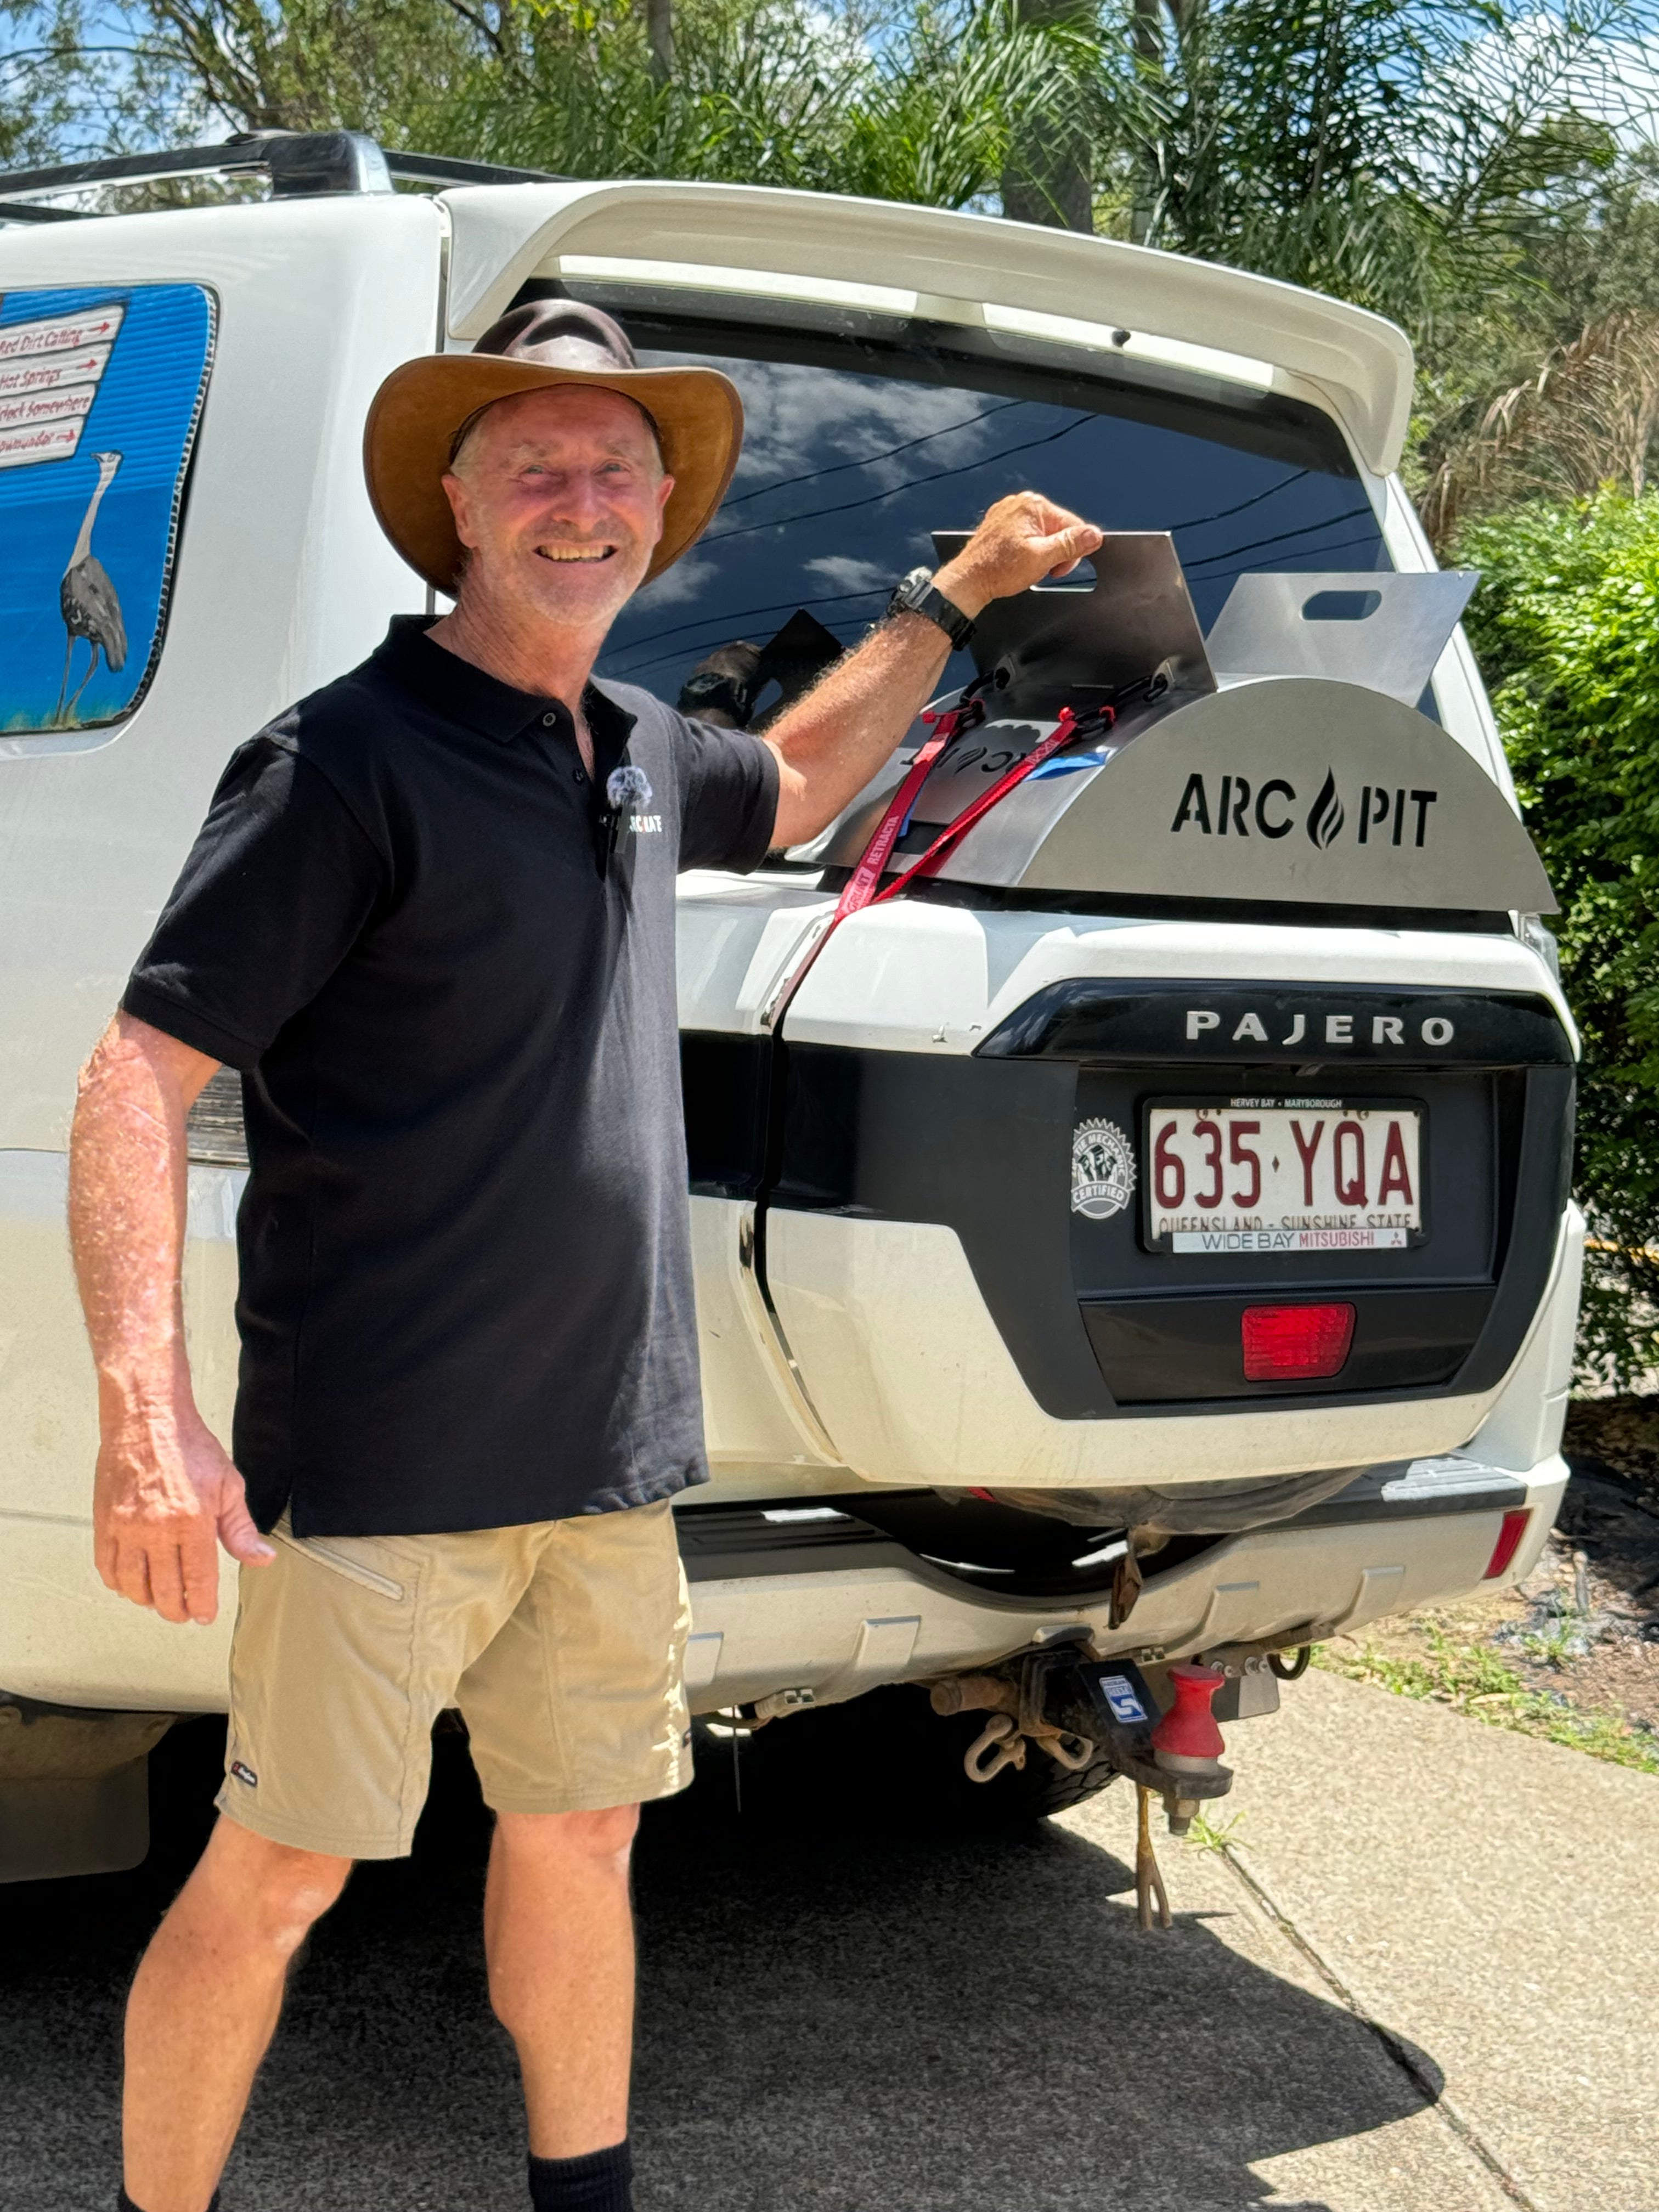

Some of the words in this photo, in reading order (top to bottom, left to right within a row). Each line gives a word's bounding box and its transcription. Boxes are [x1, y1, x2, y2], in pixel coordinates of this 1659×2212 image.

[20, 334, 44, 352] Dirt
[45, 329, 83, 347] Calling
[20, 367, 63, 388] Springs
[26, 394, 90, 417] Somewhere
[1171, 773, 1296, 839] ARC
[1358, 786, 1437, 847] PIT
[867, 815, 900, 865] RETRACTA
[1186, 1011, 1454, 1046] PAJERO
[1230, 1098, 1259, 1107] HERVEY
[1260, 1098, 1275, 1108] BAY
[1284, 1099, 1342, 1108] MARYBOROUGH
[1075, 1140, 1088, 1156] TIE
[1088, 1134, 1125, 1177] MECHANIC
[1073, 1184, 1125, 1204] CERTIFIED
[1159, 1216, 1262, 1232] QUEENSLAND
[1281, 1215, 1356, 1231] SUNSHINE
[1367, 1213, 1412, 1228] STATE
[1201, 1233, 1253, 1250] WIDE
[1257, 1232, 1295, 1249] BAY
[1299, 1231, 1374, 1248] MITSUBISHI
